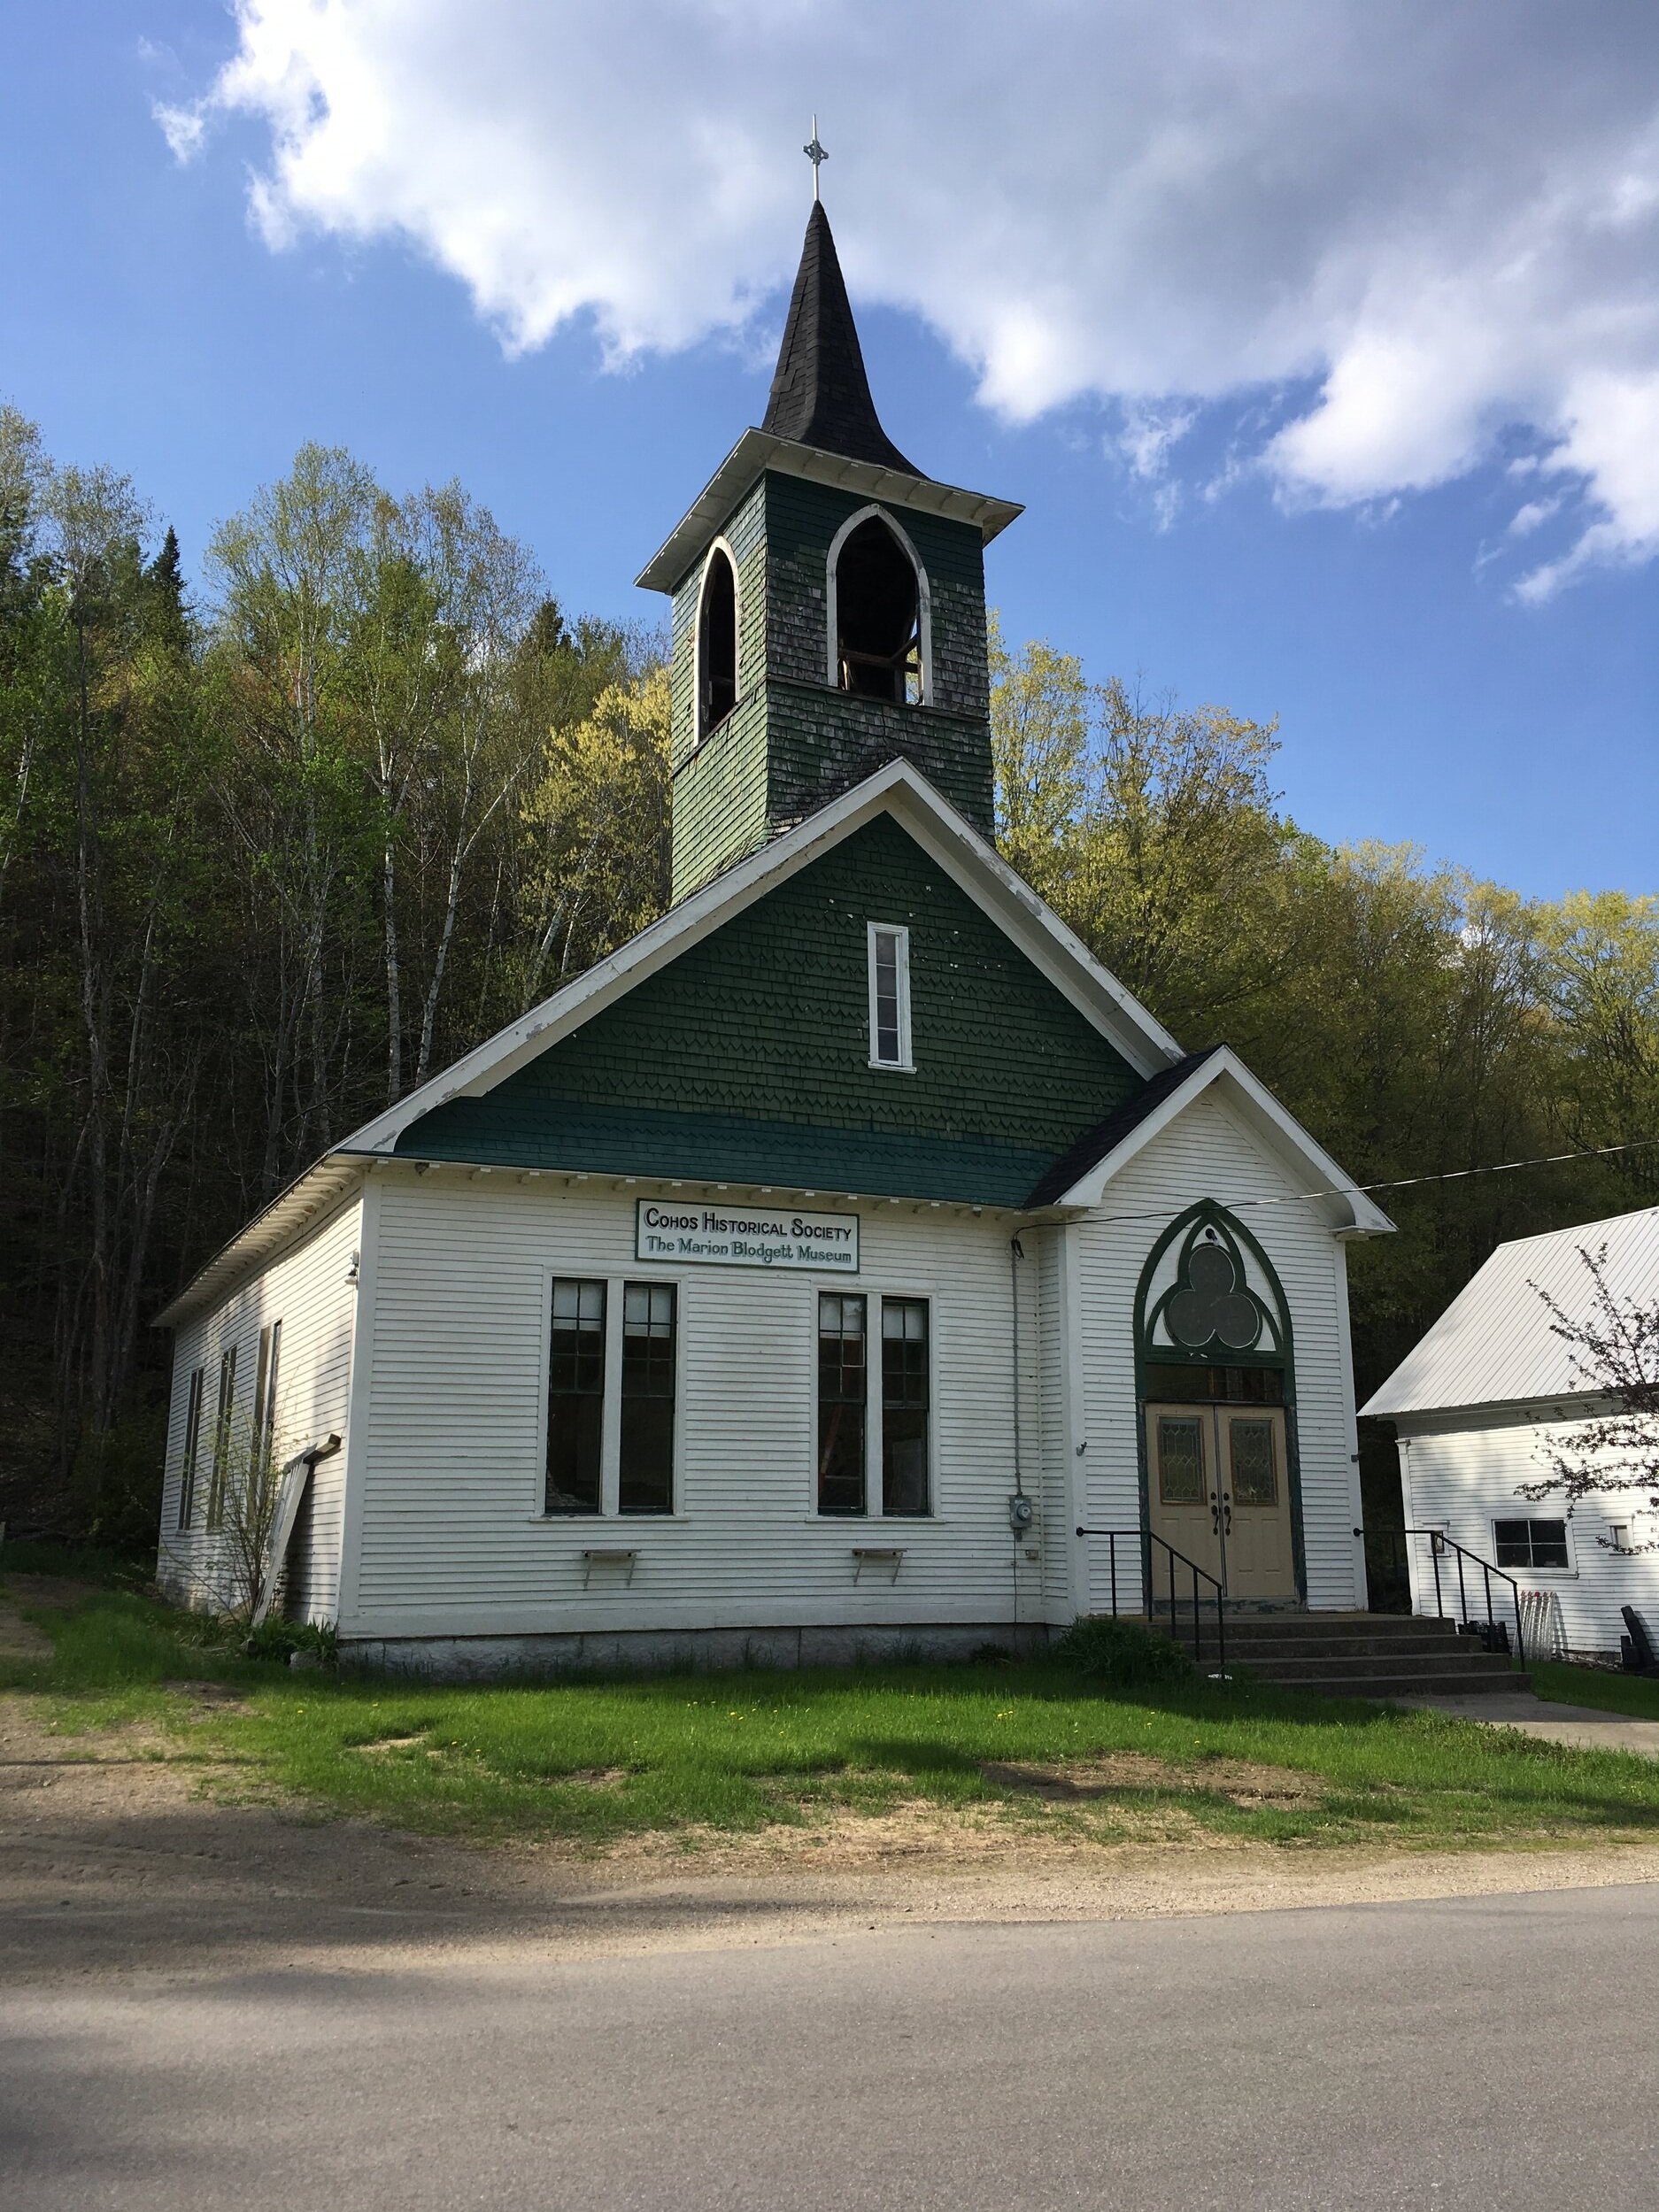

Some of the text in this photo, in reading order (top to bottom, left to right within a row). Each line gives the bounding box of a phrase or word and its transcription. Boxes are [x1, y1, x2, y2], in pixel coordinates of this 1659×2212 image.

[647, 1236, 852, 1264] The Marion Blodgett Museum
